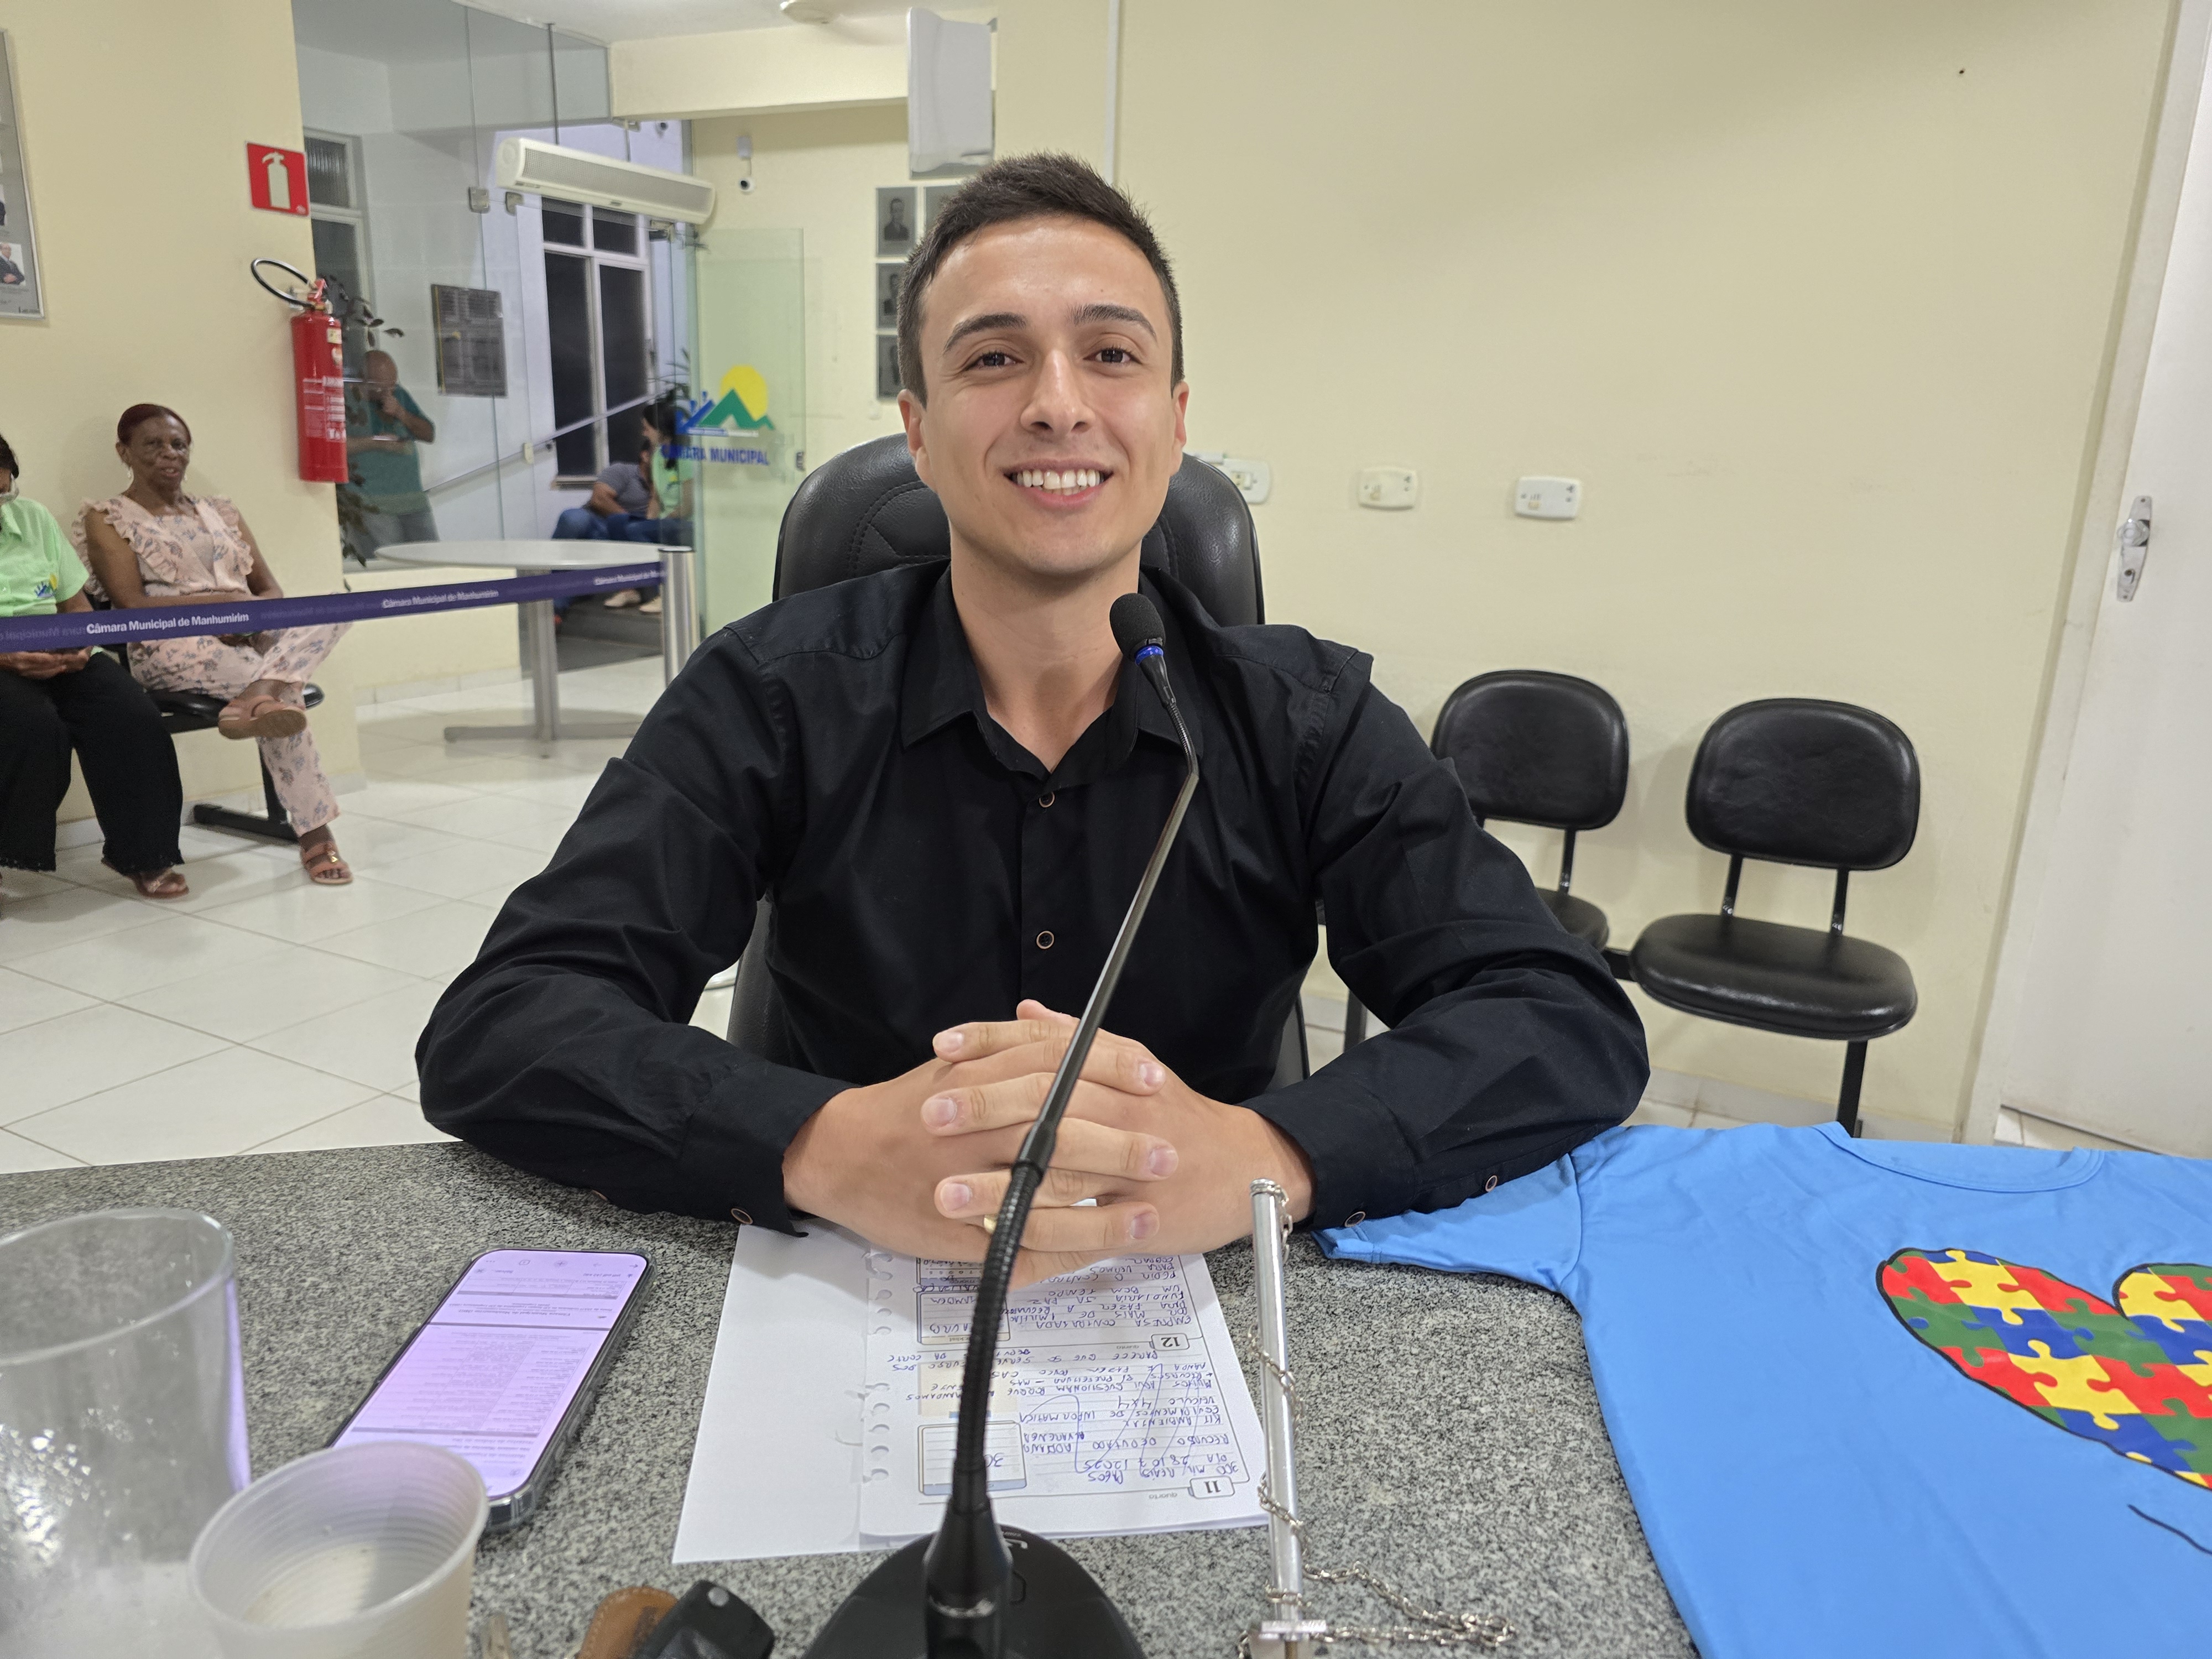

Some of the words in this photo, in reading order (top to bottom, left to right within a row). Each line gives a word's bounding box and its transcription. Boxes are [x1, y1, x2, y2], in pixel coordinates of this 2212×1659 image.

[709, 447, 769, 466] MUNICIPAL
[87, 623, 127, 634] Câmara
[129, 618, 176, 631] Municipal
[178, 617, 190, 627] de
[191, 612, 249, 626] Manhumirim
[1161, 1336, 1181, 1348] 12
[1203, 1414, 1221, 1425] KIT
[1203, 1480, 1221, 1494] 11
